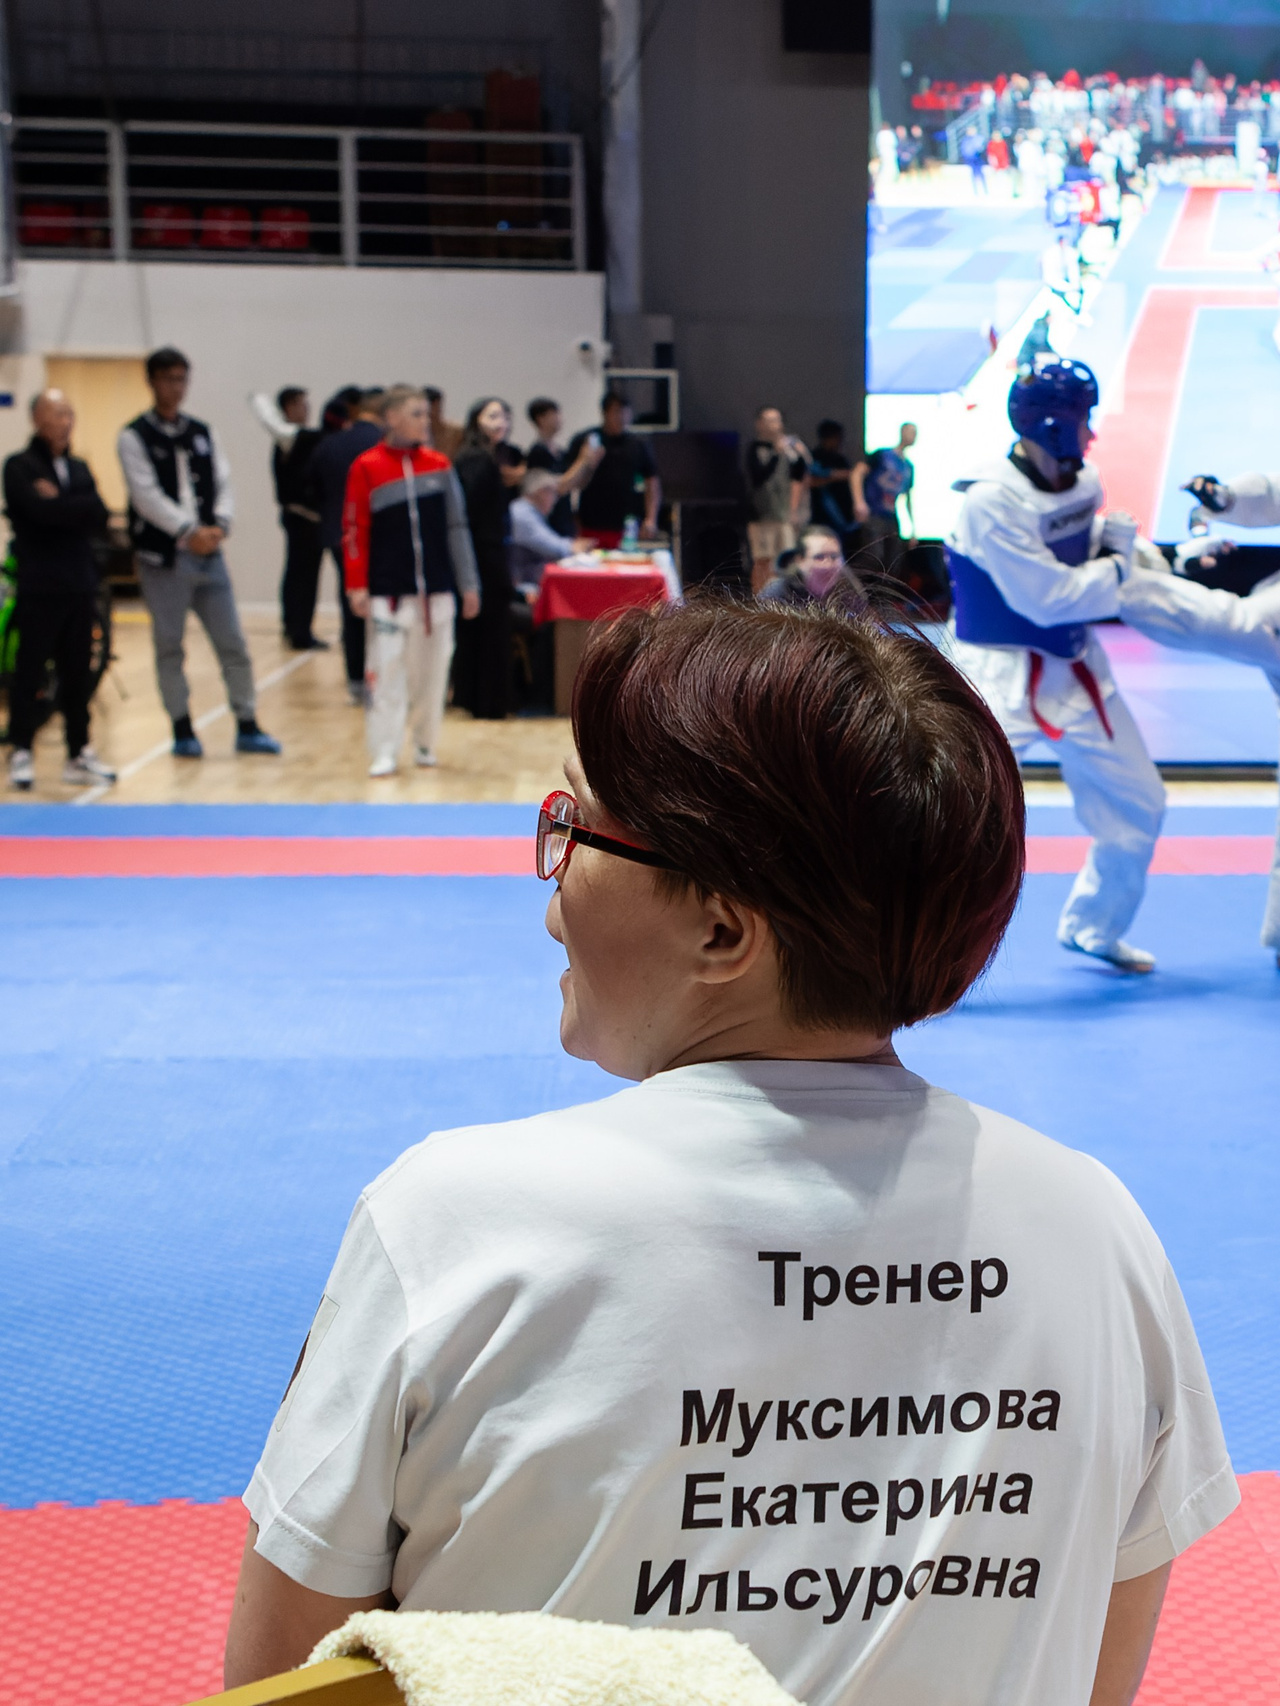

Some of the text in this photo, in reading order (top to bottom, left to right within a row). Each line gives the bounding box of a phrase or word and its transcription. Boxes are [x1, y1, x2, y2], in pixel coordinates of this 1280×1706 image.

[758, 1251, 1008, 1321] Тренер
[680, 1387, 1062, 1458] Муксимова
[680, 1471, 1034, 1536] Екатерина
[633, 1554, 1042, 1625] Ильсуровна
